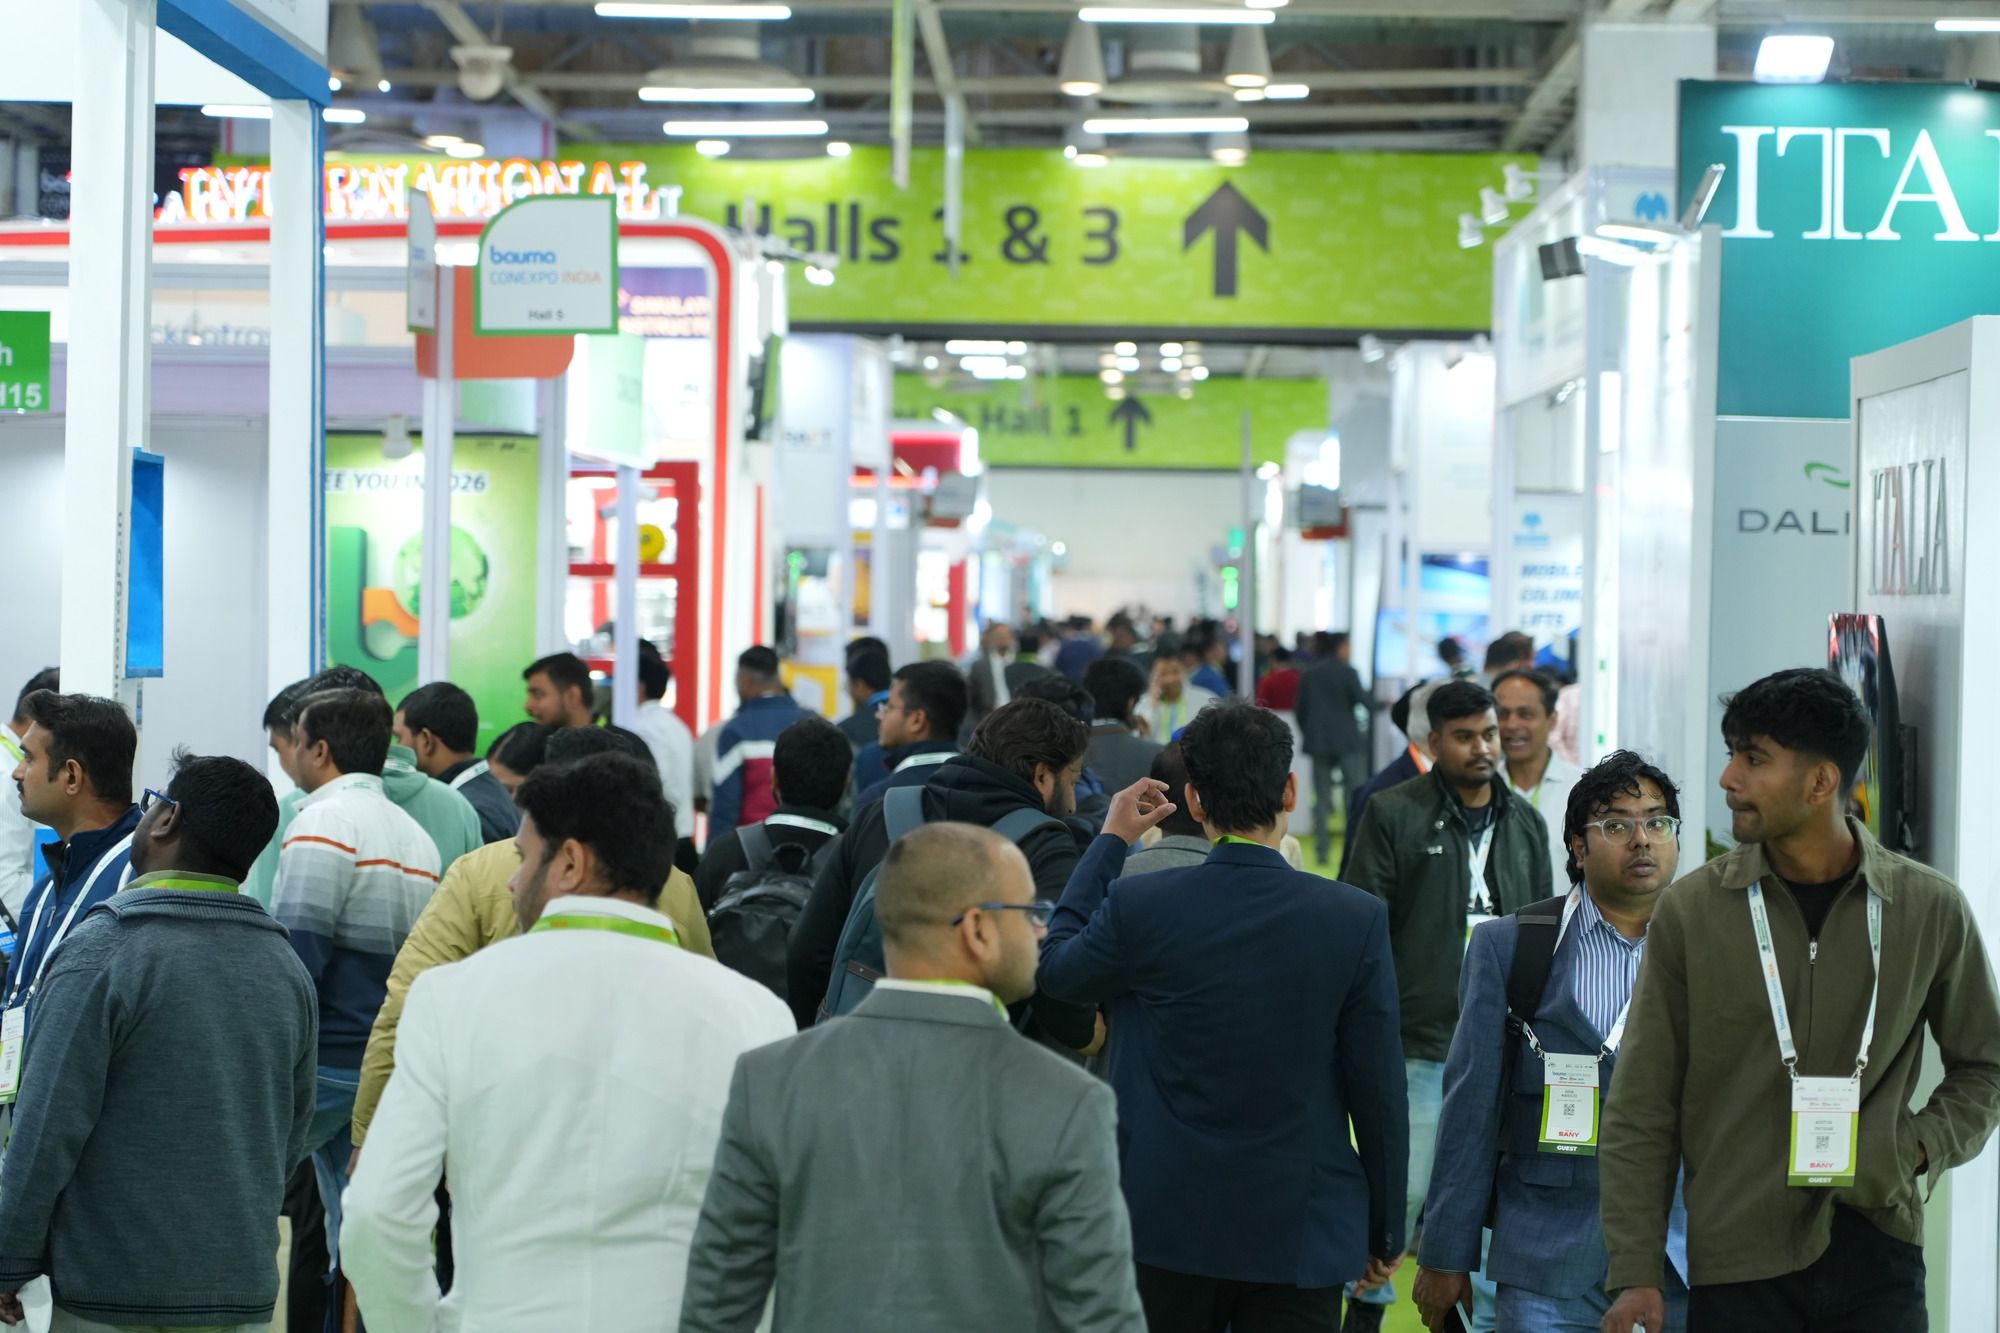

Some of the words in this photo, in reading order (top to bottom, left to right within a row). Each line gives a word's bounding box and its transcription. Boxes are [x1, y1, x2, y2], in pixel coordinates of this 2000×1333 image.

[1720, 125, 2000, 242] ITA
[725, 202, 902, 263] Halls
[932, 207, 970, 264] 1
[1002, 205, 1050, 264] &
[1081, 206, 1121, 264] 3
[489, 246, 556, 265] bauma
[489, 272, 559, 286] CONEXPO
[562, 271, 602, 285] INDIA
[528, 309, 552, 321] Hall
[354, 473, 398, 491] YOU
[1867, 457, 1951, 597] ITALIA
[1556, 1144, 1578, 1152] GUEST
